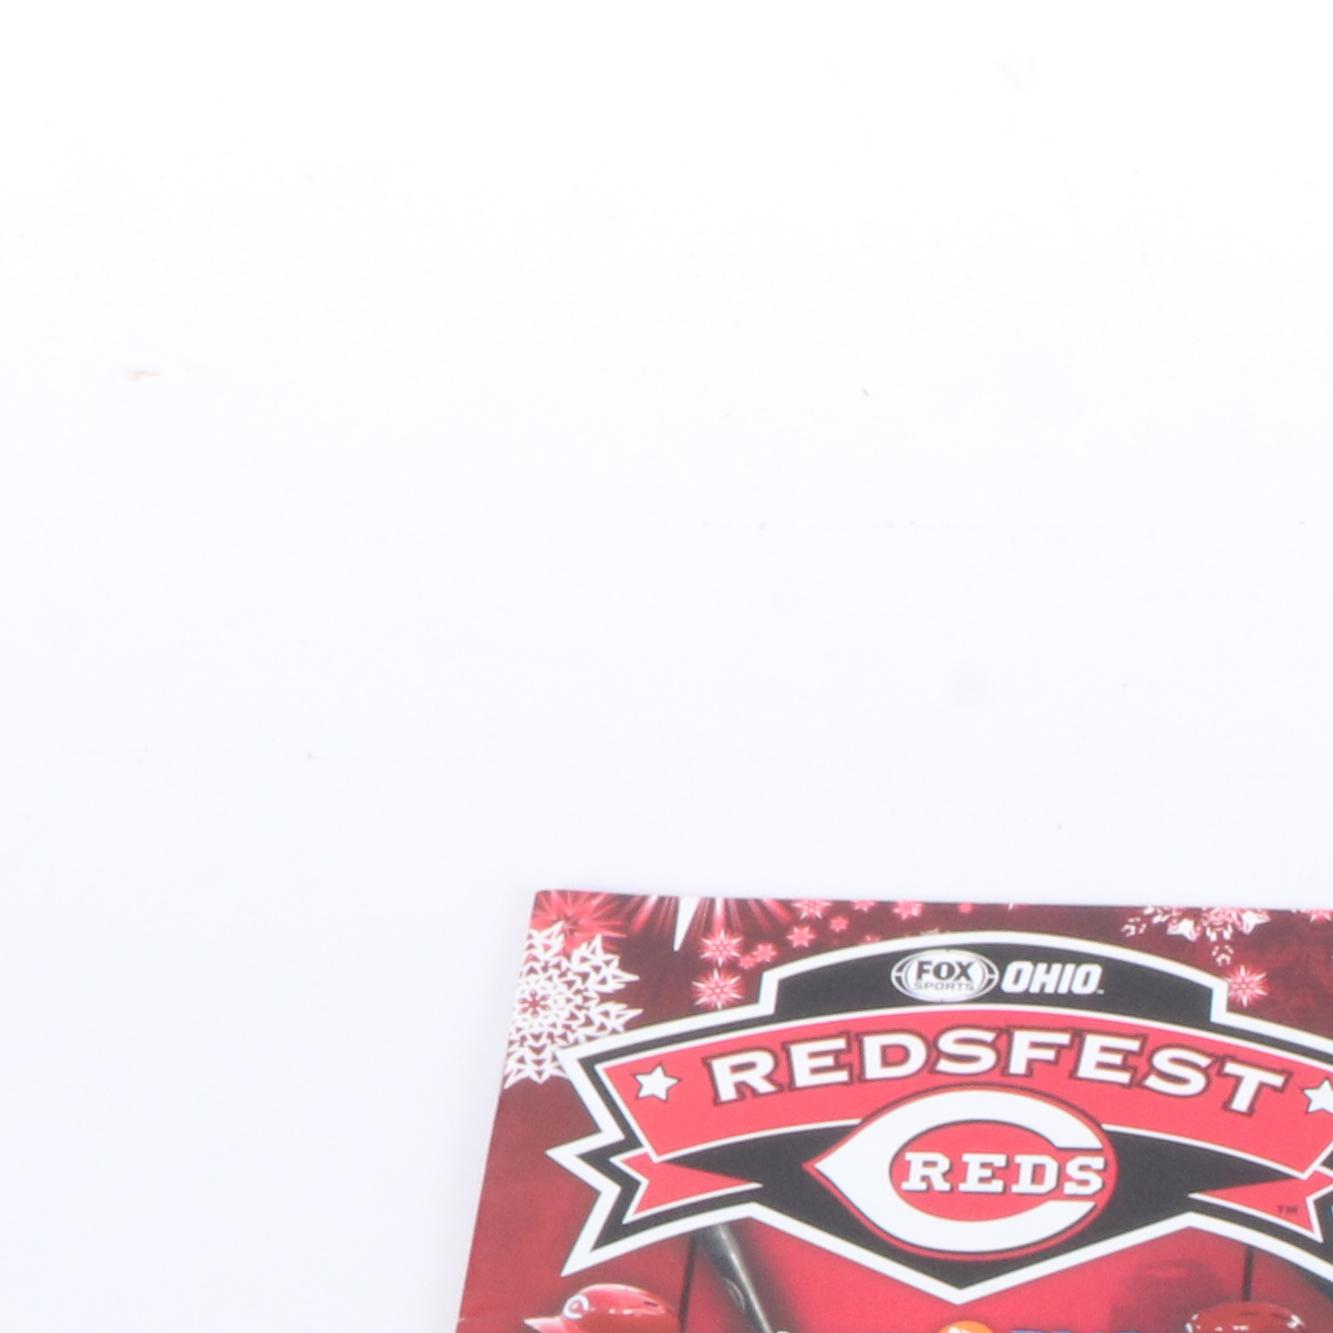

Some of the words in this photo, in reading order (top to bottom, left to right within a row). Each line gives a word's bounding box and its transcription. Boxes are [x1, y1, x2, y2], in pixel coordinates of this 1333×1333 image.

[914, 981, 975, 992] SPORTS
[916, 960, 976, 982] FOX
[1001, 960, 1103, 995] OHIO
[705, 1027, 1287, 1115] REDSFEST
[902, 1149, 1105, 1197] REDS
